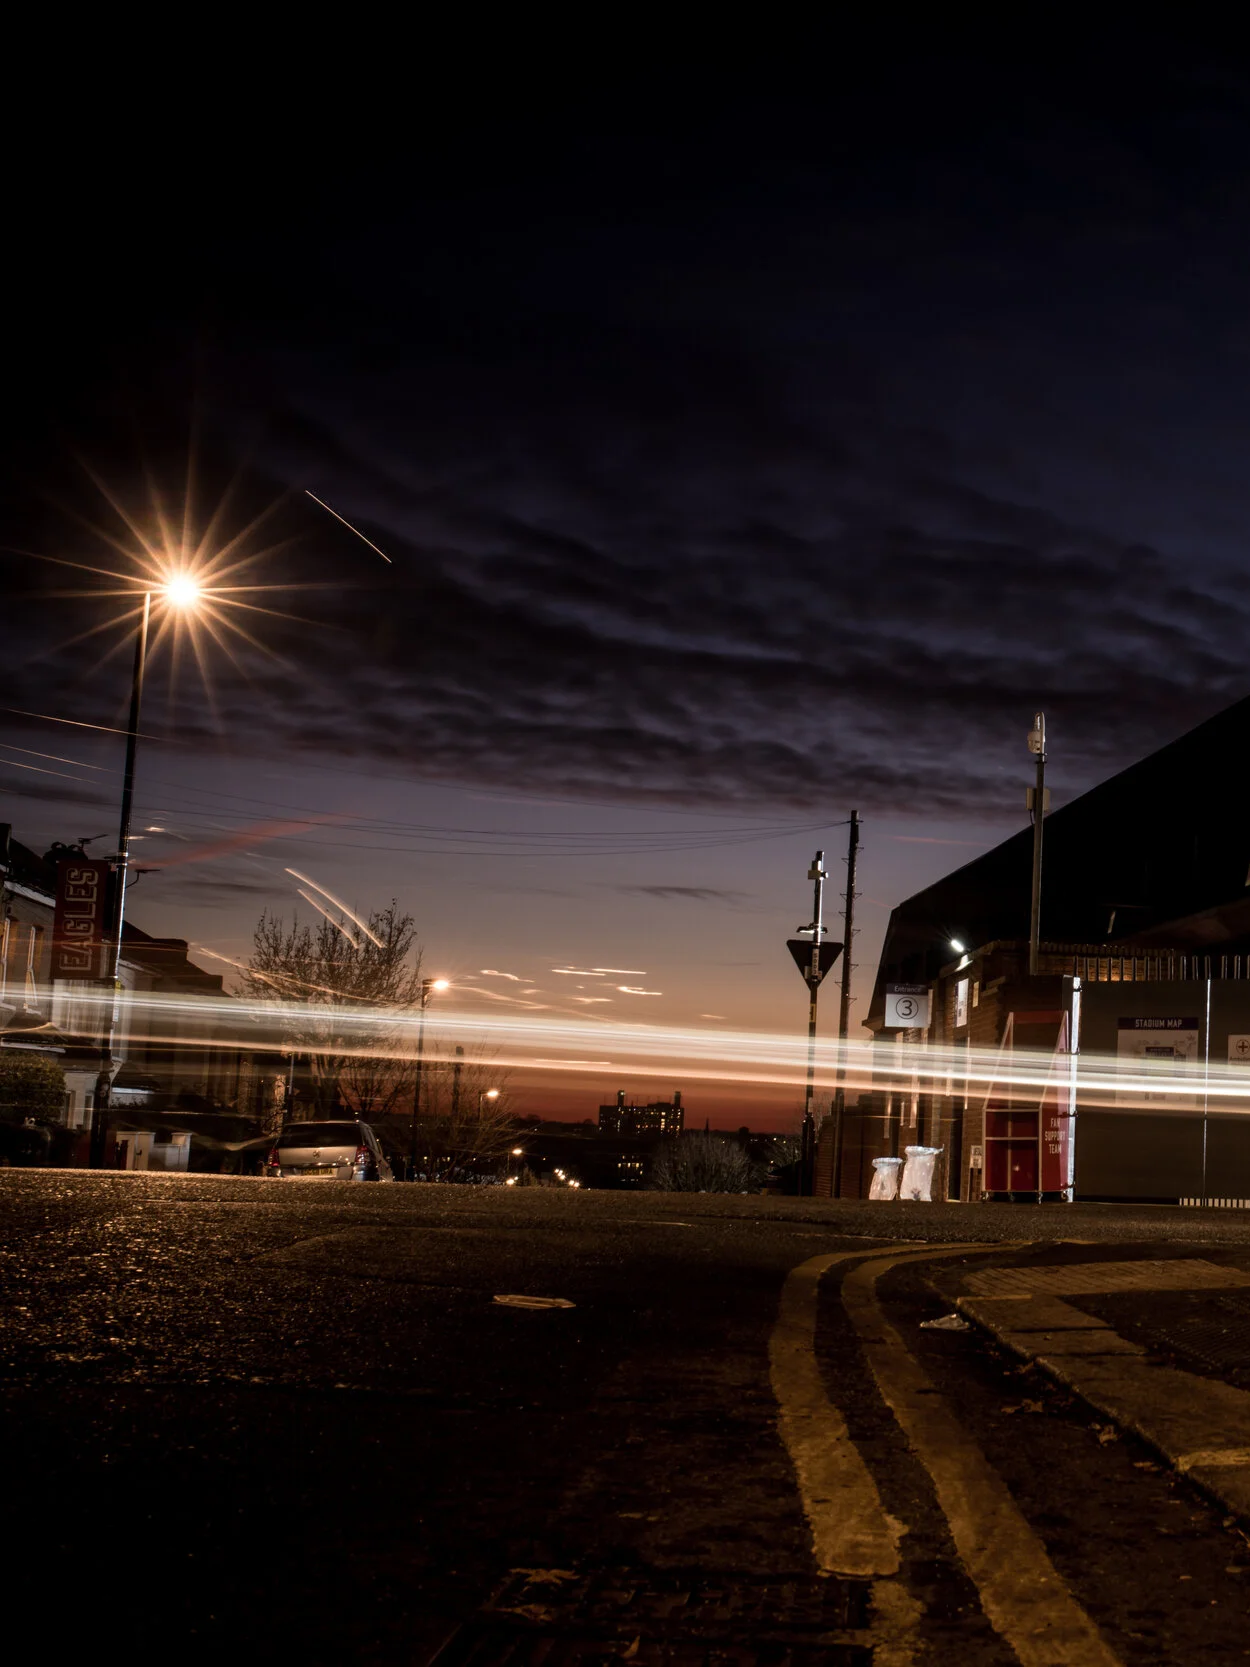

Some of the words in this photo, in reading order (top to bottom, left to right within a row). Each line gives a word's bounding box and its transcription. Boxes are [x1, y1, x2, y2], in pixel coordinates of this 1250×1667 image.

[59, 867, 99, 971] EAGLES
[902, 999, 913, 1016] 3
[1135, 1019, 1165, 1028] STADIUM
[1167, 1019, 1183, 1028] MAP
[1050, 1117, 1061, 1127] FAN
[1045, 1131, 1066, 1141] SUPPORT
[1049, 1143, 1062, 1154] TEAM
